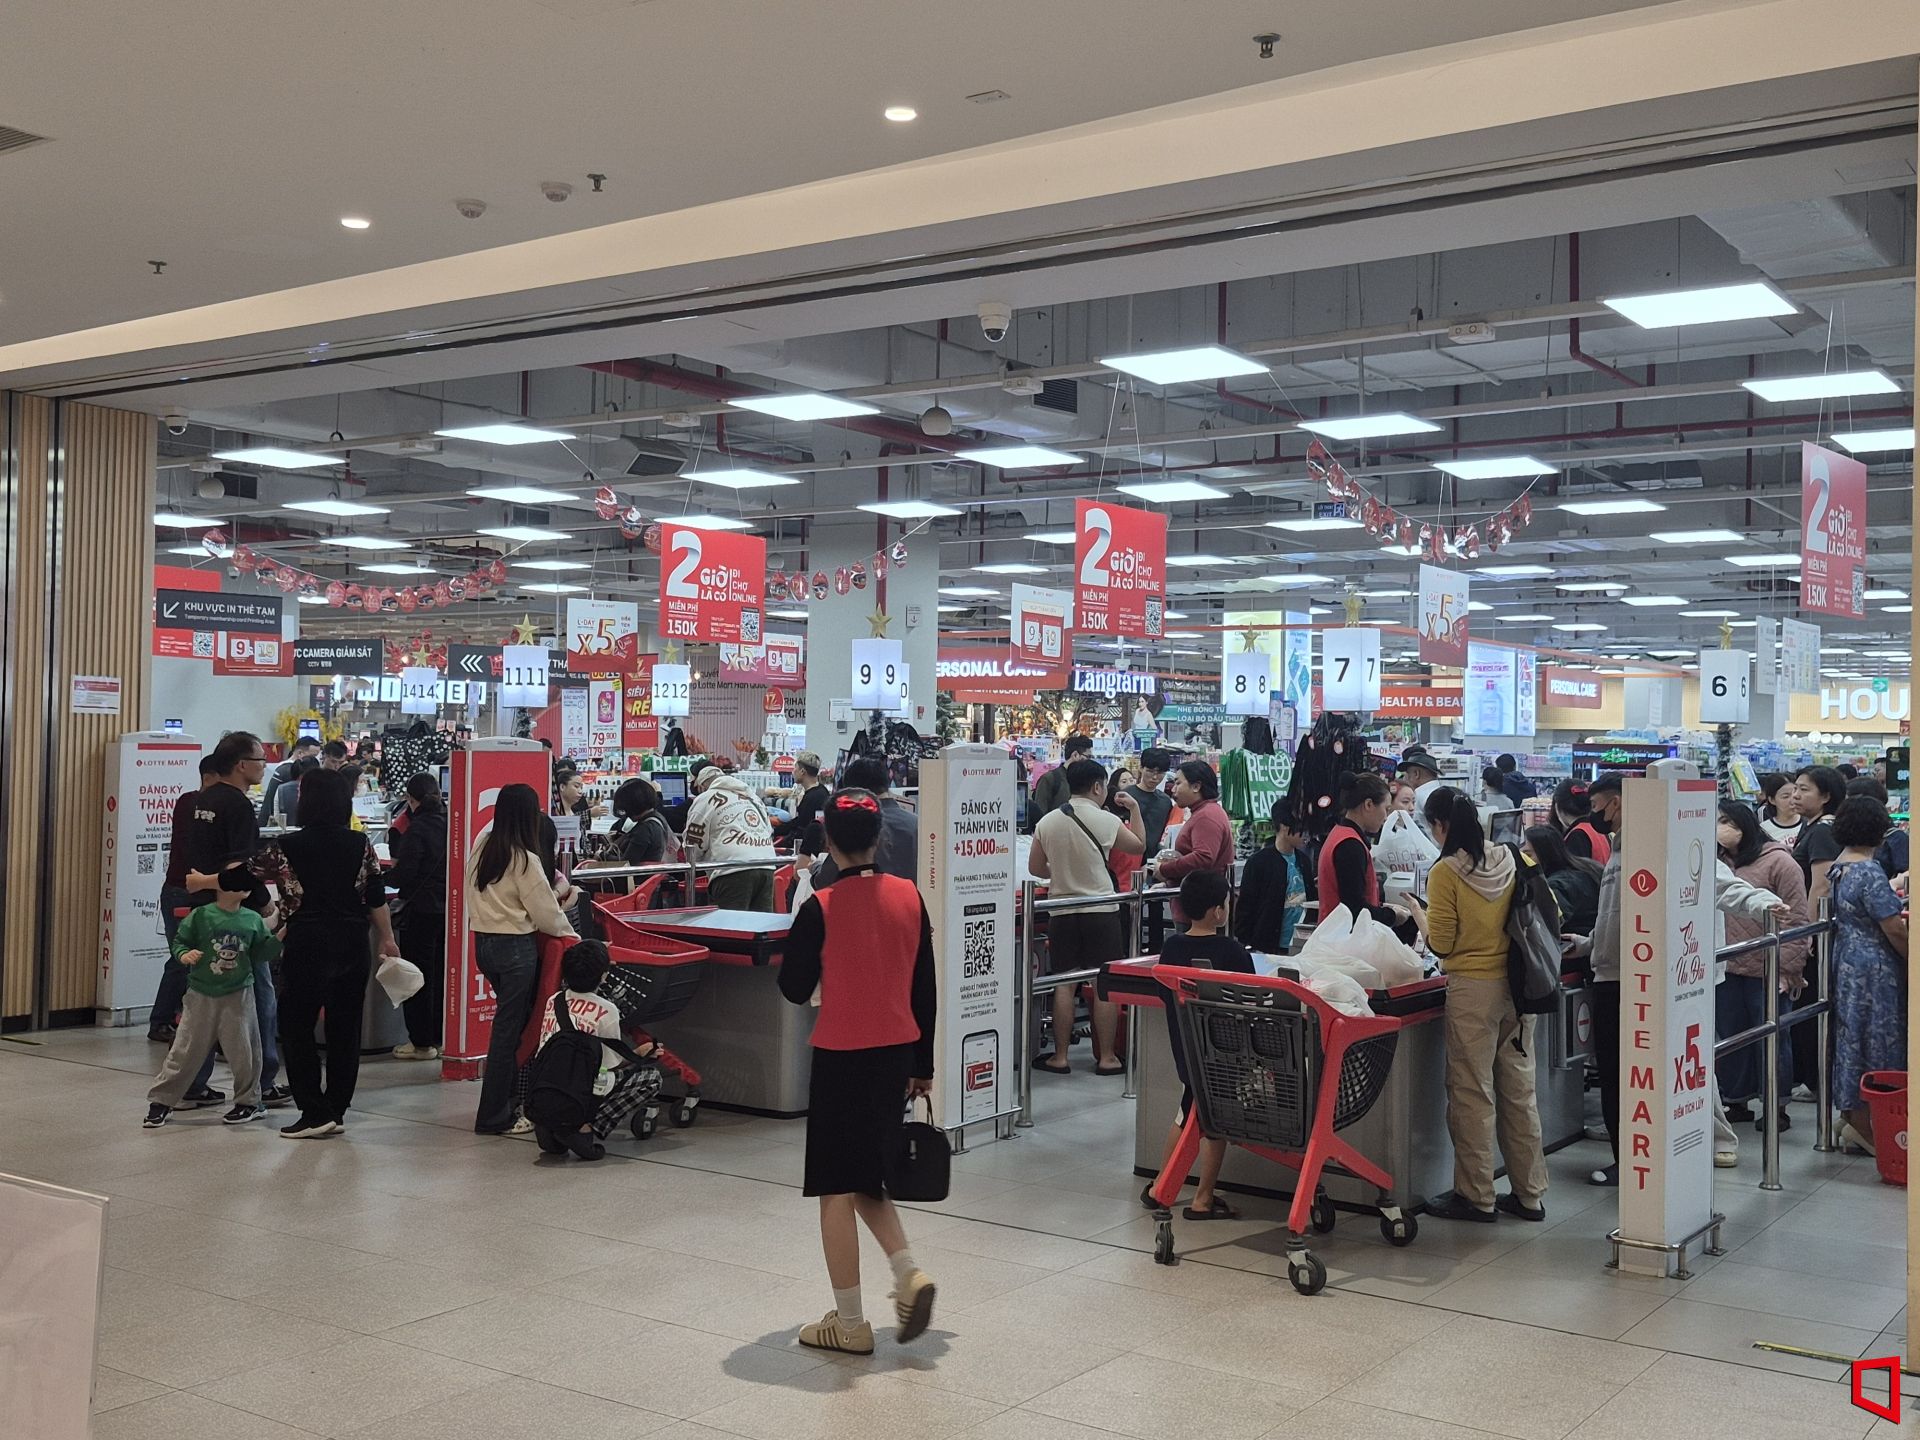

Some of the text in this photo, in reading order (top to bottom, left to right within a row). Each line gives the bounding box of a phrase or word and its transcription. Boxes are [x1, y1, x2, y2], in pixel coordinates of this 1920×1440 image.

[1806, 454, 1829, 553] 2
[1080, 508, 1112, 587] 2
[666, 530, 702, 598] 2
[733, 568, 740, 578] ĐI
[732, 580, 748, 592] CHỢ
[1111, 572, 1134, 590] LÀ CÓ
[1138, 580, 1159, 592] ONLINE
[701, 586, 726, 601] LÀ CÓ
[732, 593, 757, 604] ONLINE
[1807, 584, 1827, 608] 150K
[184, 602, 276, 618] KHU VỰC IN THẺ TẠM
[687, 602, 698, 612] PHÍ
[668, 619, 698, 636] 150K
[1082, 611, 1108, 630] 150K
[1029, 626, 1036, 640] 9
[236, 641, 245, 656] 9
[303, 646, 372, 658] CAMERA GIÁM SÁT
[772, 652, 776, 664] 9
[505, 668, 523, 686] 11
[526, 668, 546, 686] 11
[860, 664, 871, 684] 9
[886, 664, 895, 684] 9
[936, 660, 1002, 678] ERSONAL
[1334, 658, 1350, 682] 7
[1367, 658, 1375, 682] 7
[403, 684, 416, 697] 14
[419, 685, 434, 698] 14
[654, 683, 669, 698] 12
[672, 683, 687, 698] 12
[1235, 675, 1246, 693] 8
[1259, 675, 1265, 693] 8
[1712, 675, 1727, 696] 6
[1741, 676, 1746, 698] 6
[1380, 696, 1422, 706] HEALTH
[1425, 697, 1434, 706] &
[1821, 688, 1909, 720] HOU
[986, 768, 1002, 776] MART
[140, 783, 183, 795] ĐĂNG KÝ
[139, 796, 179, 809] THÀN
[962, 798, 1002, 815] ĐĂNG KÝ
[954, 817, 1009, 835] THÀNH VIÊN
[954, 838, 996, 858] +15,000
[102, 822, 114, 980] LOTTE MART
[1630, 914, 1655, 1190] LOTTE MART
